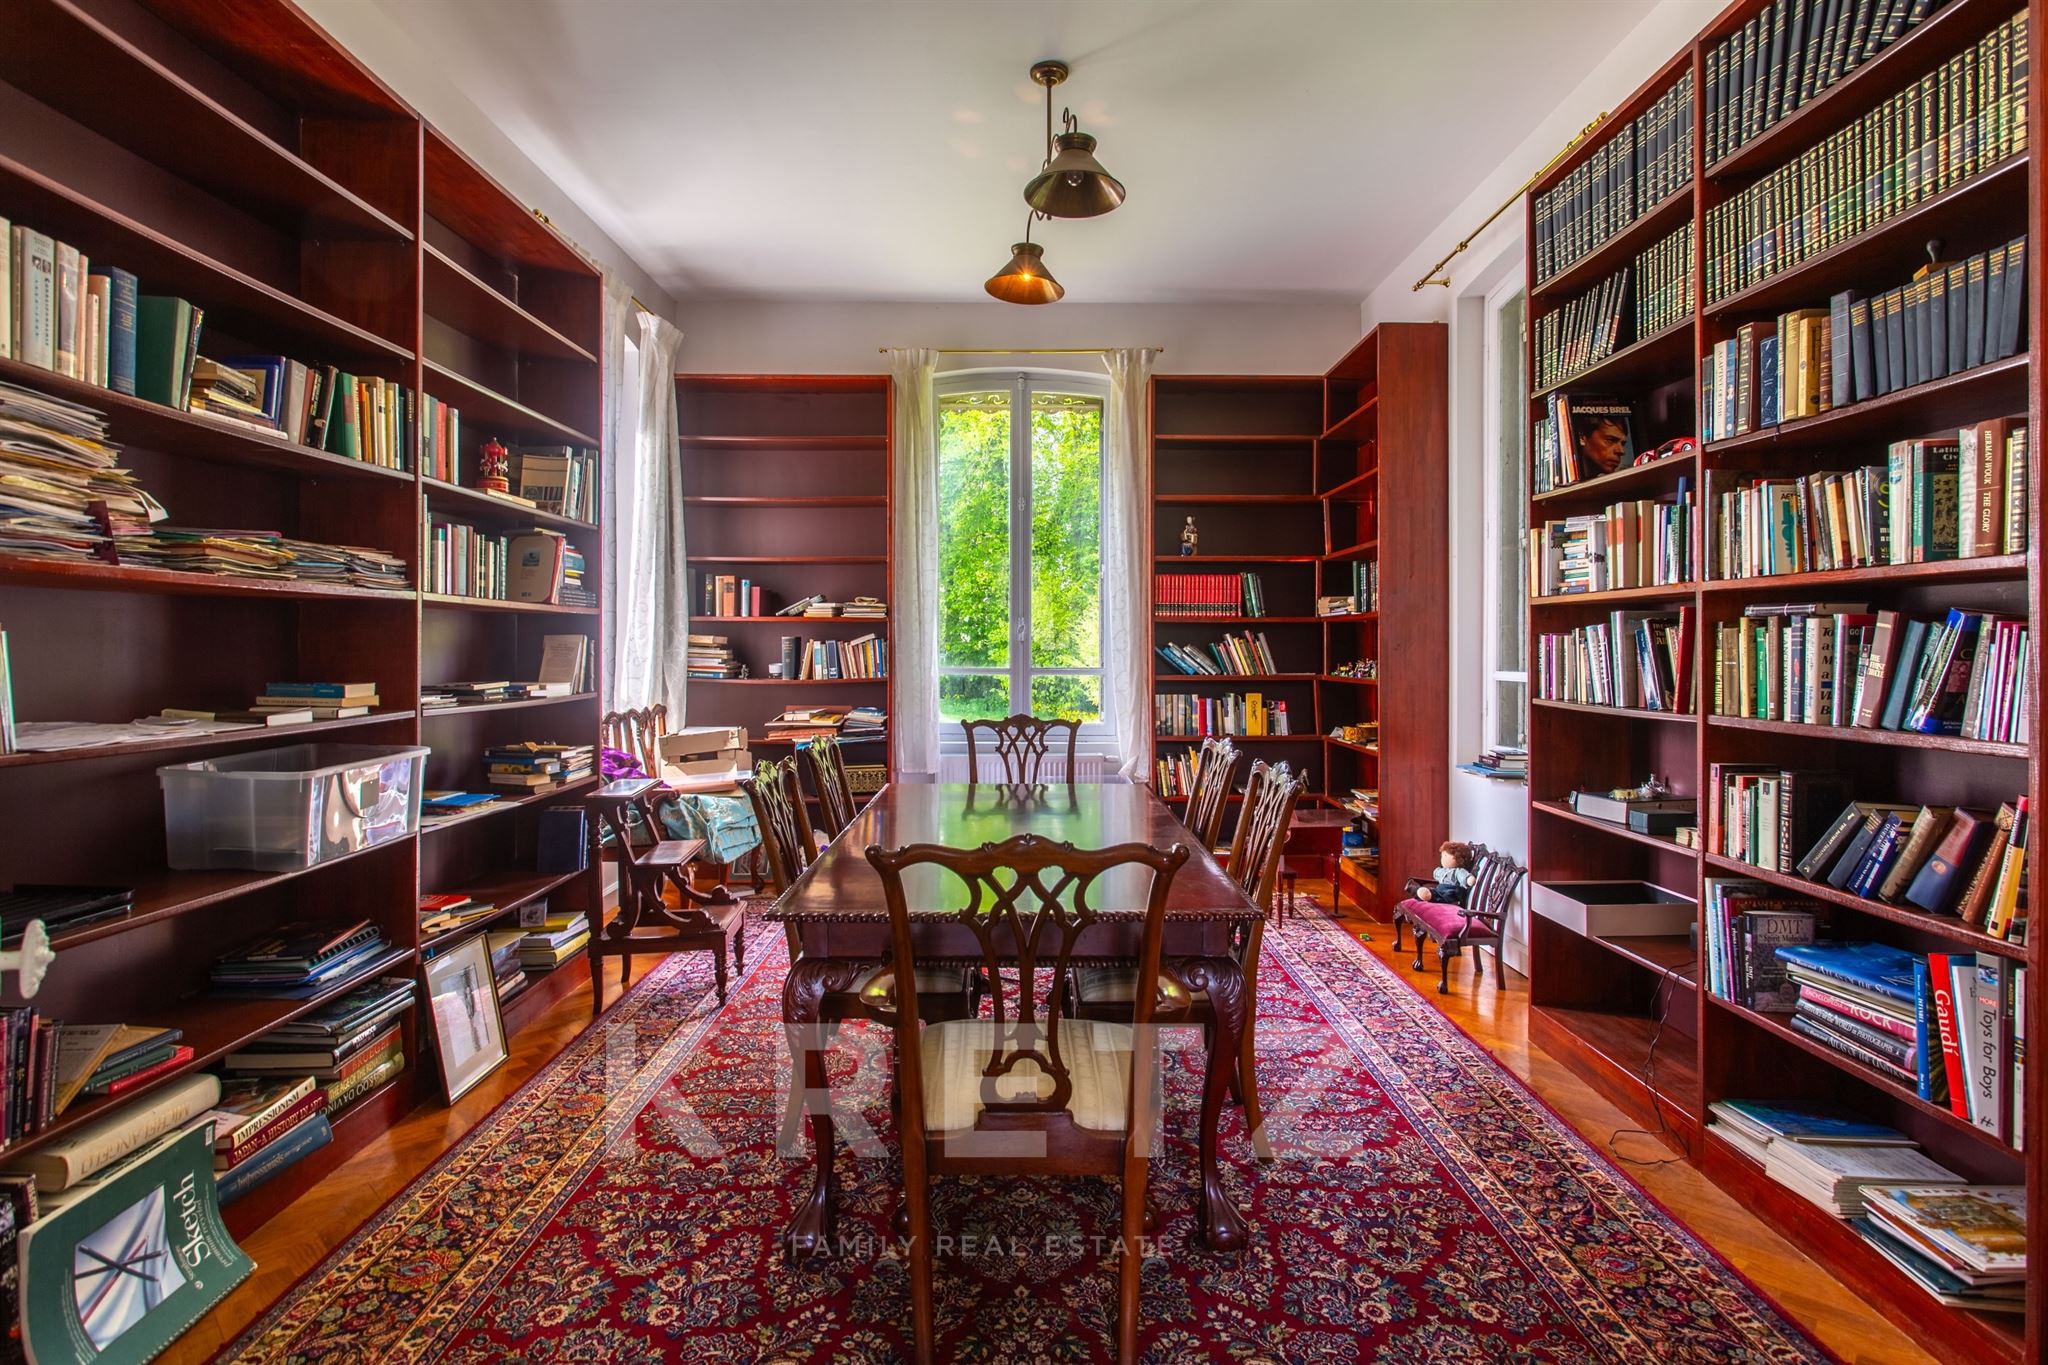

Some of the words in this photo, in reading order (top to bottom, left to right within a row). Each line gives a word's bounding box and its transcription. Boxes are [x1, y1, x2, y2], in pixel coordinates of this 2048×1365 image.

[2002, 46, 2010, 68] Great
[1966, 70, 1974, 92] Great
[2002, 68, 2010, 94] Books
[1966, 92, 1974, 117] Books
[1572, 406, 1608, 414] JACQUES
[1610, 406, 1632, 414] BREL
[1984, 430, 1992, 462] HERMAN
[1984, 463, 1992, 485] WOUK
[1983, 492, 1992, 508] THE
[1982, 510, 1990, 533] GLORY
[1869, 661, 1885, 670] FIRST
[1870, 654, 1880, 662] THE
[1868, 668, 1884, 678] CIRCLE
[1714, 682, 1722, 704] TRAITOR
[1767, 919, 1804, 934] DMT
[1979, 996, 1999, 1008] MORE
[1848, 1003, 1894, 1031] ROCK
[1936, 990, 1958, 1057] Gaudí
[1983, 1010, 1997, 1038] Toys
[1855, 1029, 1893, 1053] PHOTOGRAPHS
[1986, 1042, 1997, 1064] for
[1983, 1066, 1996, 1100] Boys
[237, 1090, 300, 1143] IMPRESSIONISM
[268, 1116, 300, 1140] HISTORY
[299, 1106, 309, 1119] IN
[308, 1098, 323, 1112] ART
[174, 1169, 212, 1267] Sketch
